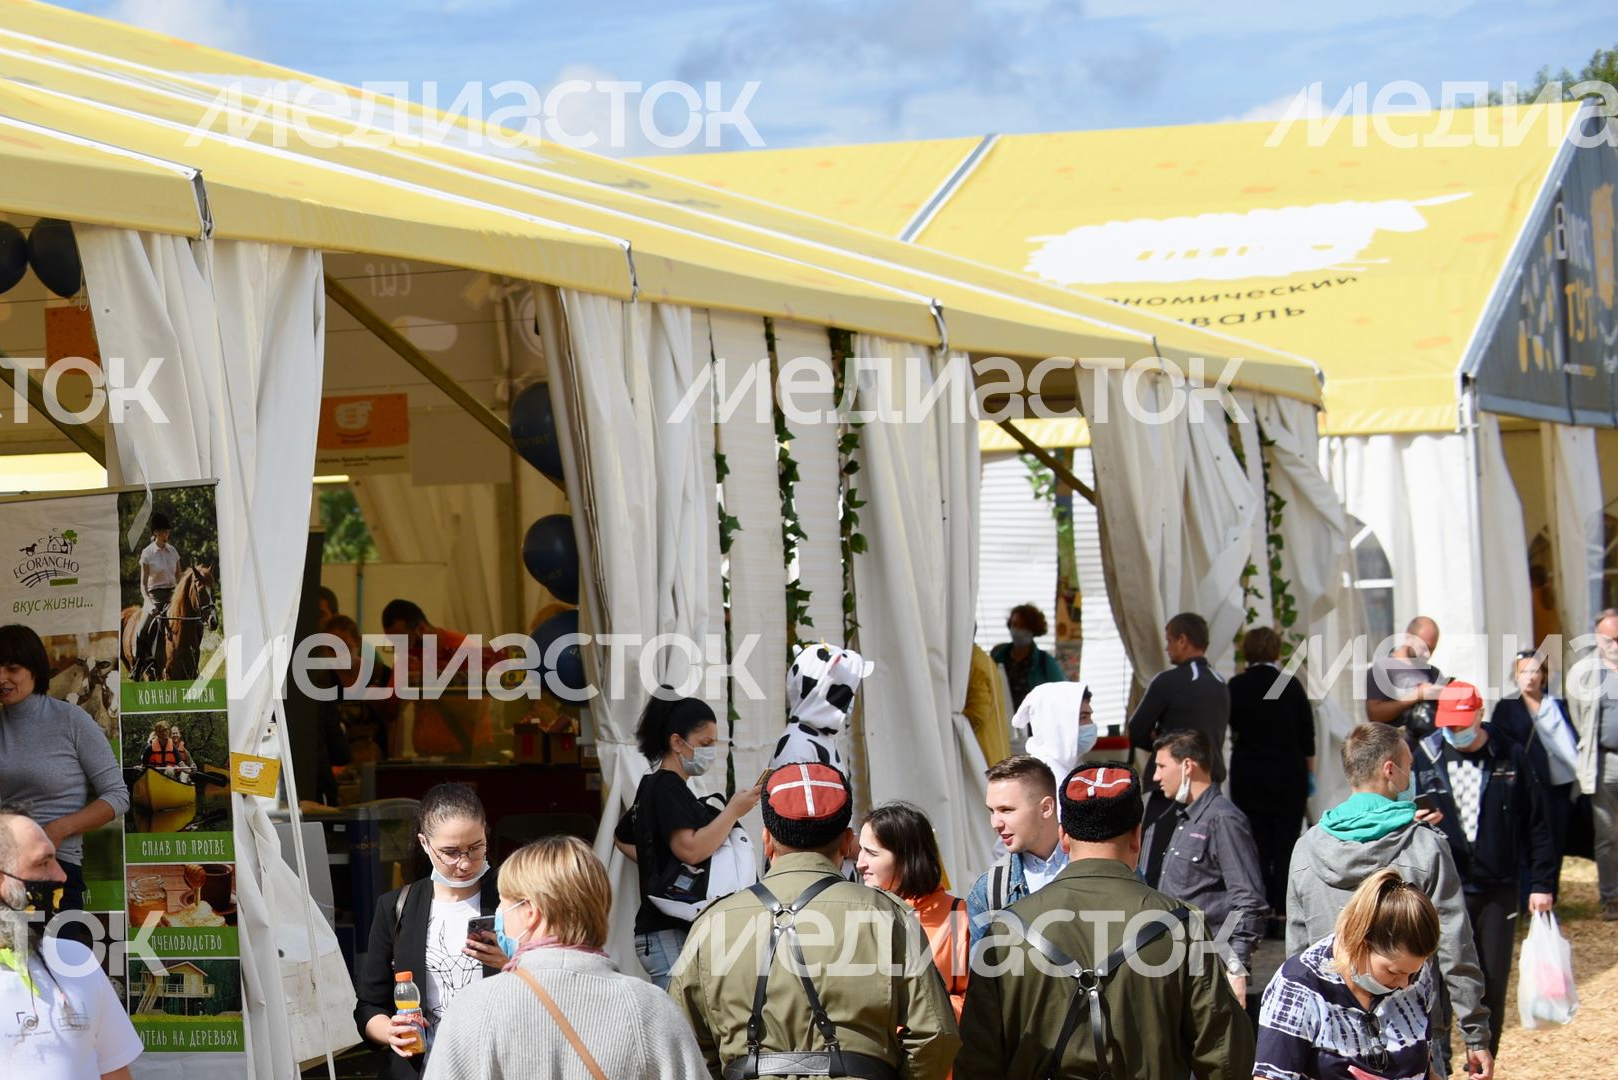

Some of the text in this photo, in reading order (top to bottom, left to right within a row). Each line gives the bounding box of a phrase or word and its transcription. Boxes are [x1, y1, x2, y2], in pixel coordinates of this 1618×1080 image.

[1178, 306, 1307, 327] валь
[13, 556, 80, 579] ECORANCHO
[13, 600, 41, 616] вкус
[138, 687, 216, 705] КОННЫЙ ТУРИЗМ
[142, 839, 225, 856] СПЛАВ ПО ПРОТВЕ
[151, 934, 222, 952] ПЧЕЛОВОДСТВО
[173, 1030, 185, 1046] НА
[189, 1029, 239, 1048] ДЕРЕВЬЯХ
